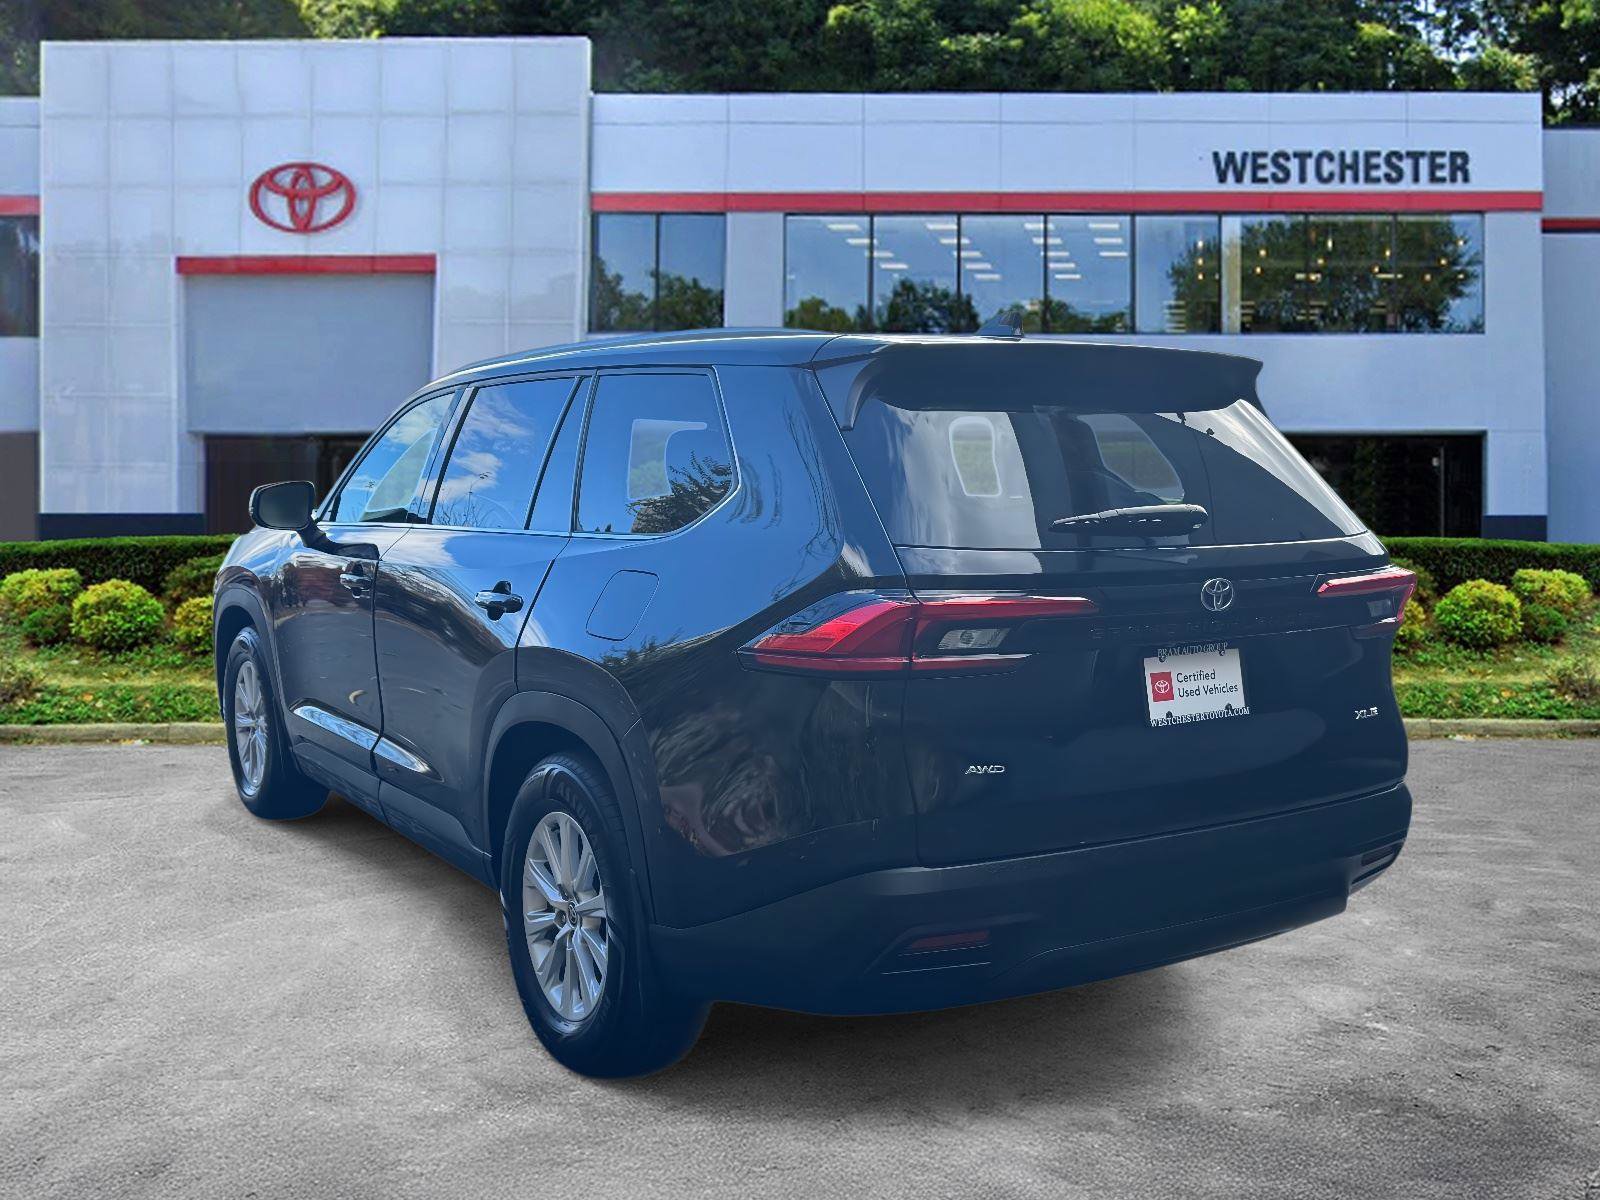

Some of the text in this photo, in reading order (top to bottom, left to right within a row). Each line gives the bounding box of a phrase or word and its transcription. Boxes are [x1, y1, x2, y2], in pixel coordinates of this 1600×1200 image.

[1212, 150, 1470, 184] WESTCHESTER
[1181, 644, 1202, 656] AUTO
[1203, 642, 1228, 653] GROUP
[1176, 669, 1216, 683] Certified
[1178, 683, 1239, 698] Used Vehicles
[1150, 706, 1250, 727] WESTCHESTERTOYOTA.COM
[965, 765, 1005, 775] AWD
